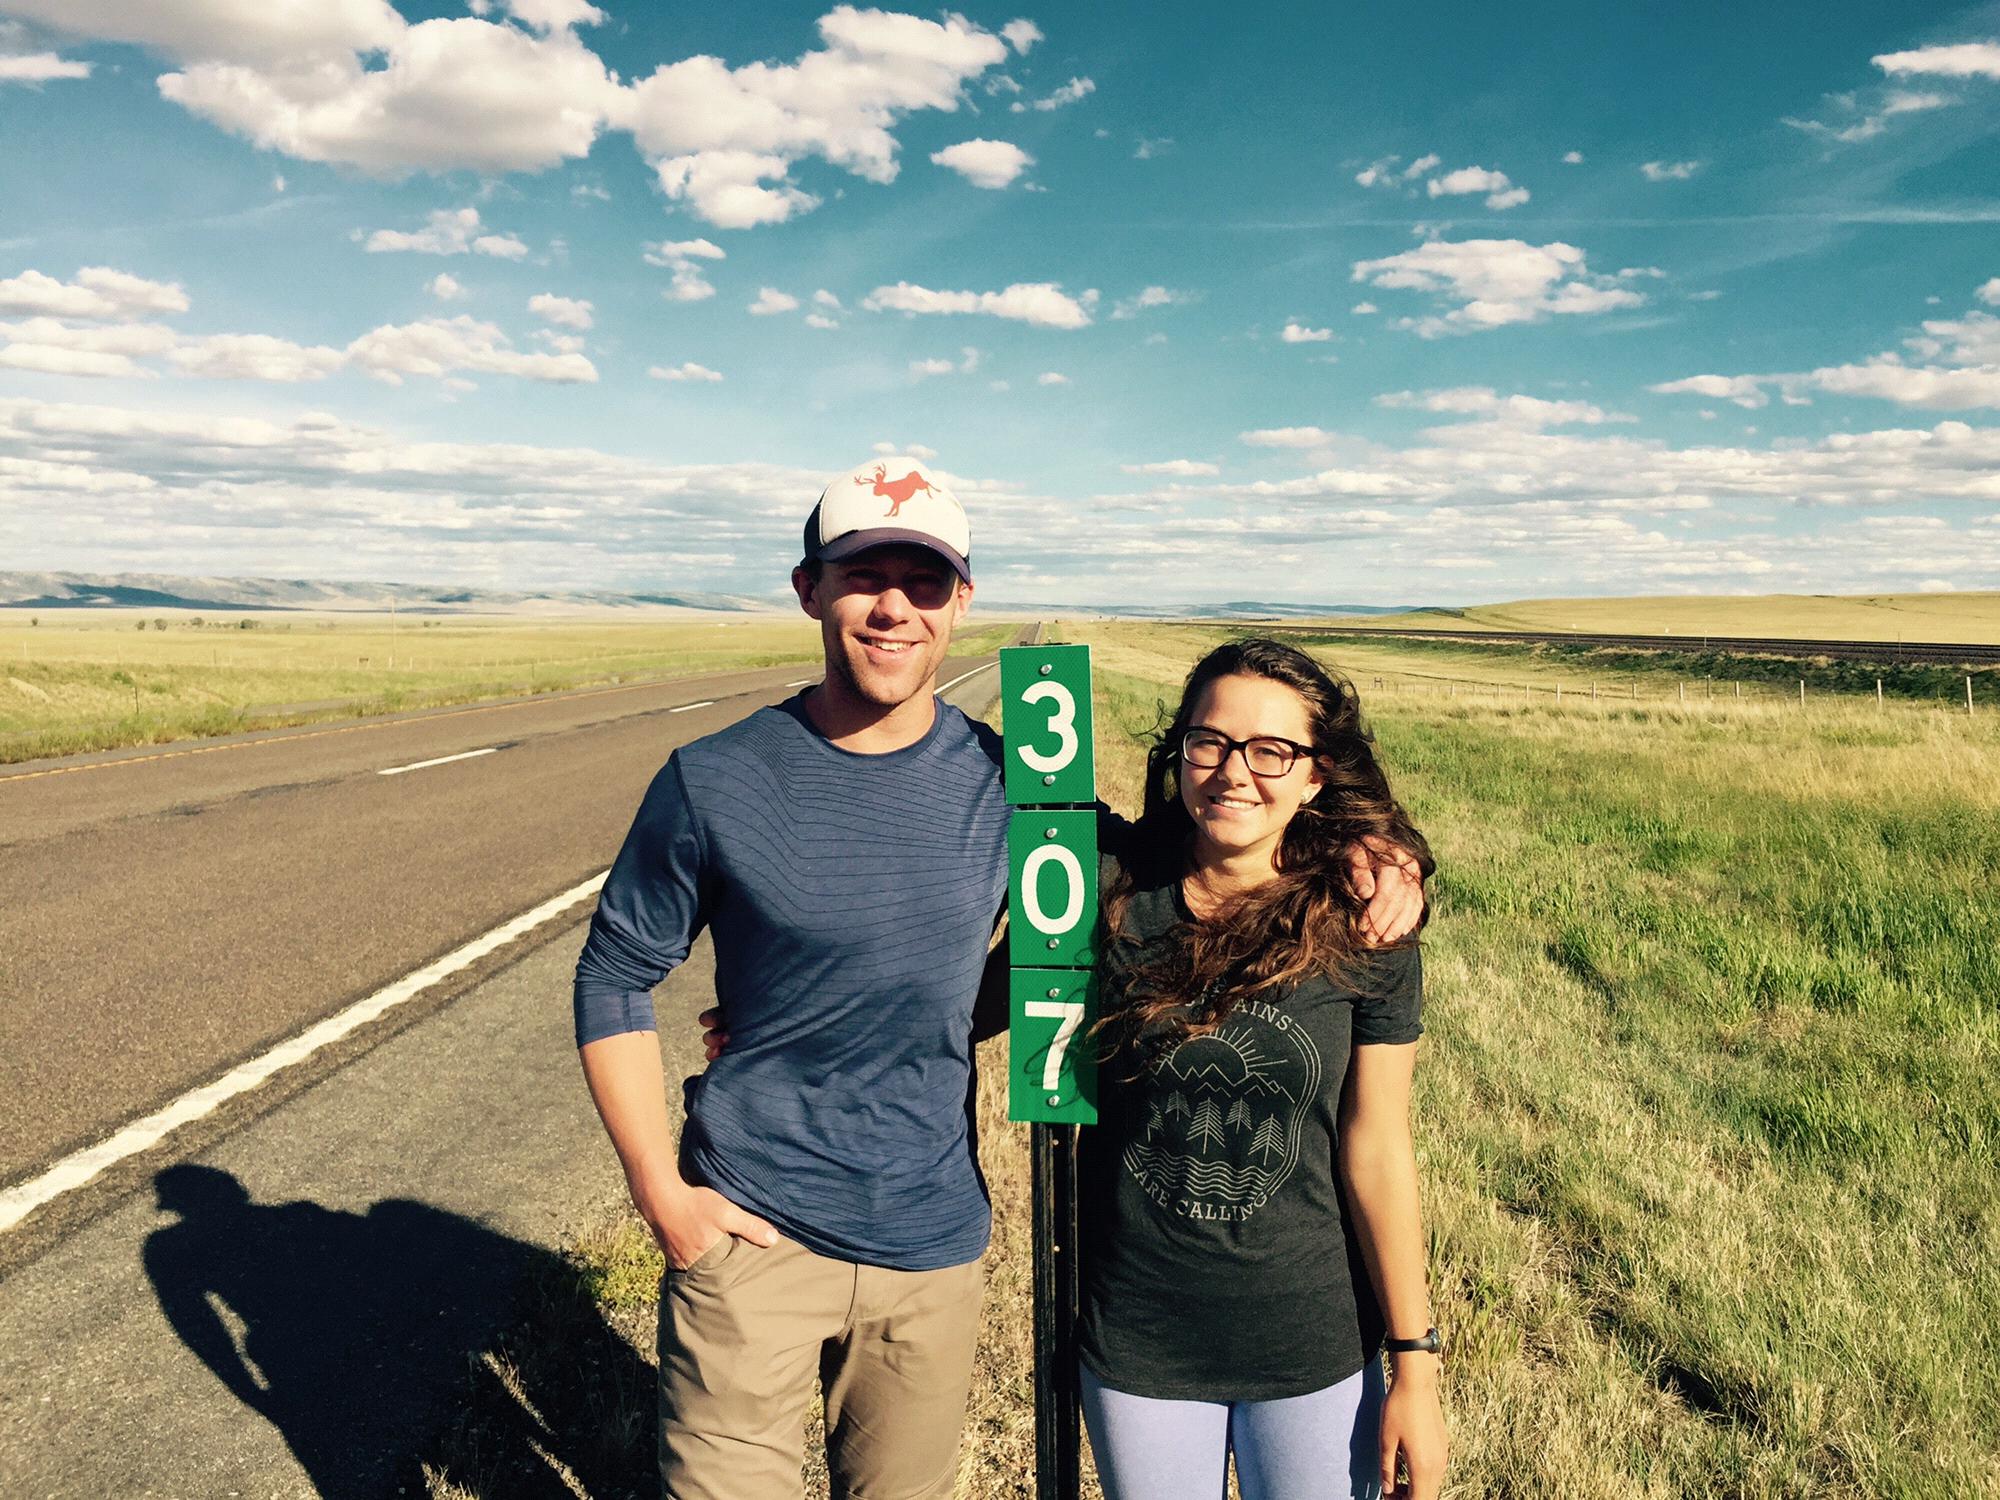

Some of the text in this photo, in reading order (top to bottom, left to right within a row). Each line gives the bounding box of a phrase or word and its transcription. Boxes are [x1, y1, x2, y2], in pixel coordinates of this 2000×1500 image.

[1231, 998, 1293, 1032] AINS
[1133, 1168, 1268, 1222] ARE CALLING
